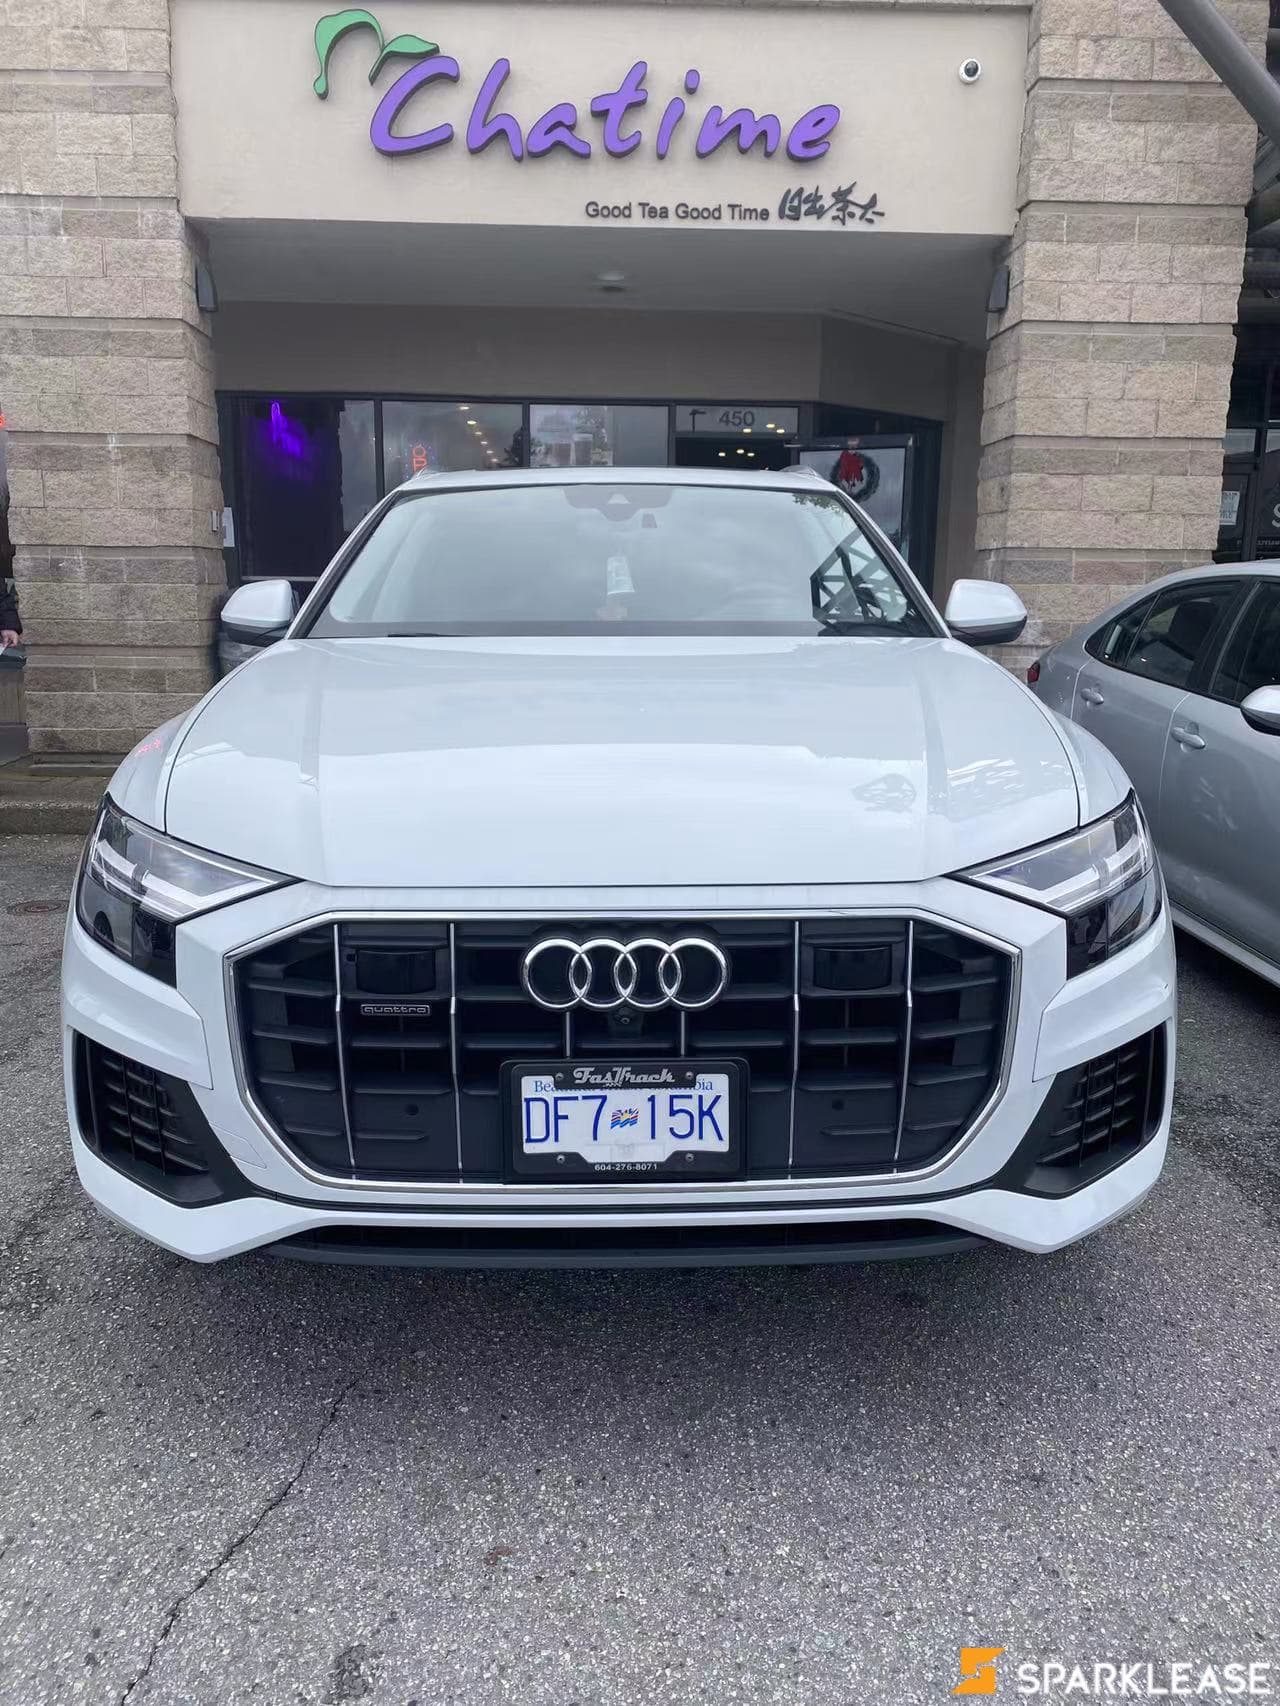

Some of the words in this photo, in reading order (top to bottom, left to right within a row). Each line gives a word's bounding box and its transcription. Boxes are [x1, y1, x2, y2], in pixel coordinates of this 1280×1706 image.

[370, 56, 841, 162] Chatime
[585, 201, 632, 219] Good
[638, 202, 669, 219] Tea
[674, 202, 722, 221] Good
[727, 203, 770, 221] Time
[719, 411, 755, 427] 450
[364, 1006, 426, 1014] quattro
[523, 1095, 607, 1143] DF7
[648, 1094, 724, 1141] 15K
